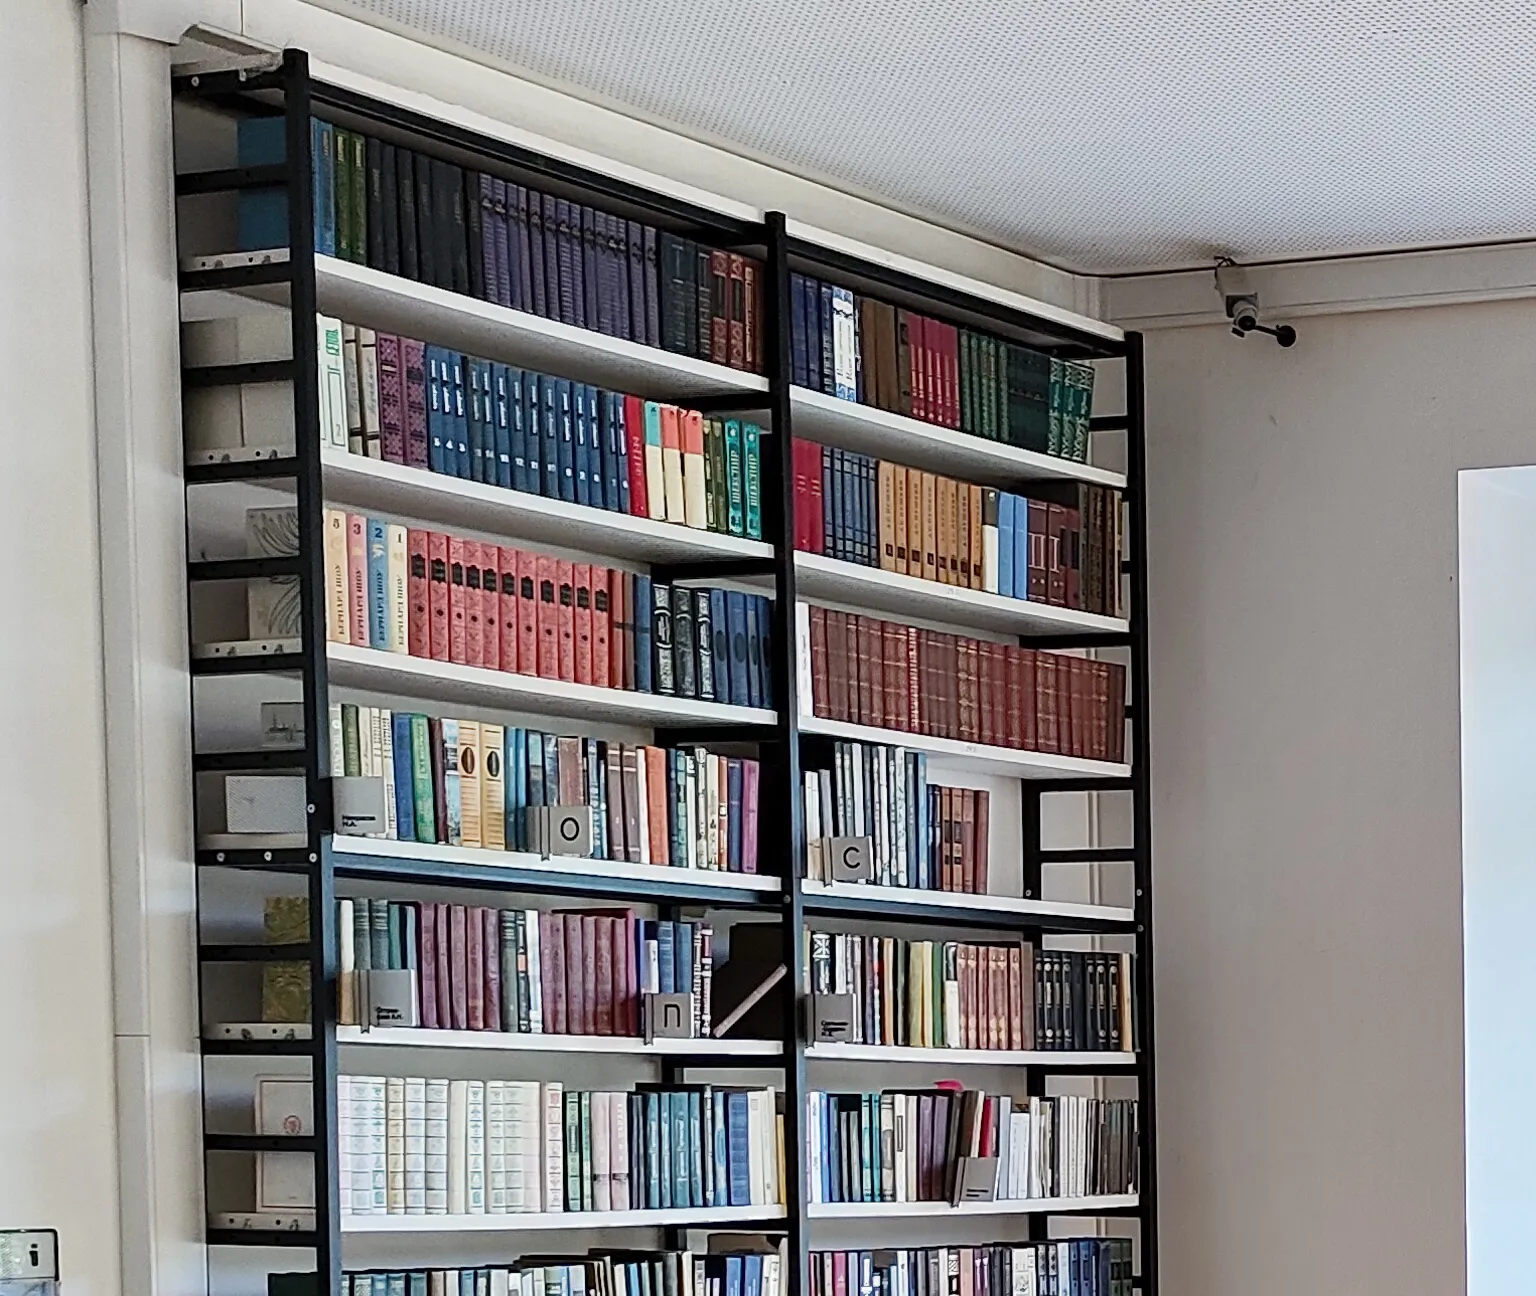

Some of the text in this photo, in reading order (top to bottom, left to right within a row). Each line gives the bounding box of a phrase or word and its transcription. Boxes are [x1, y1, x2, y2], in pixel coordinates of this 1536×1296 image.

[333, 518, 340, 529] 5
[353, 524, 361, 535] 3
[375, 527, 383, 538] 2
[398, 533, 402, 543] 1
[843, 846, 861, 870] С
[664, 1004, 681, 1028] П
